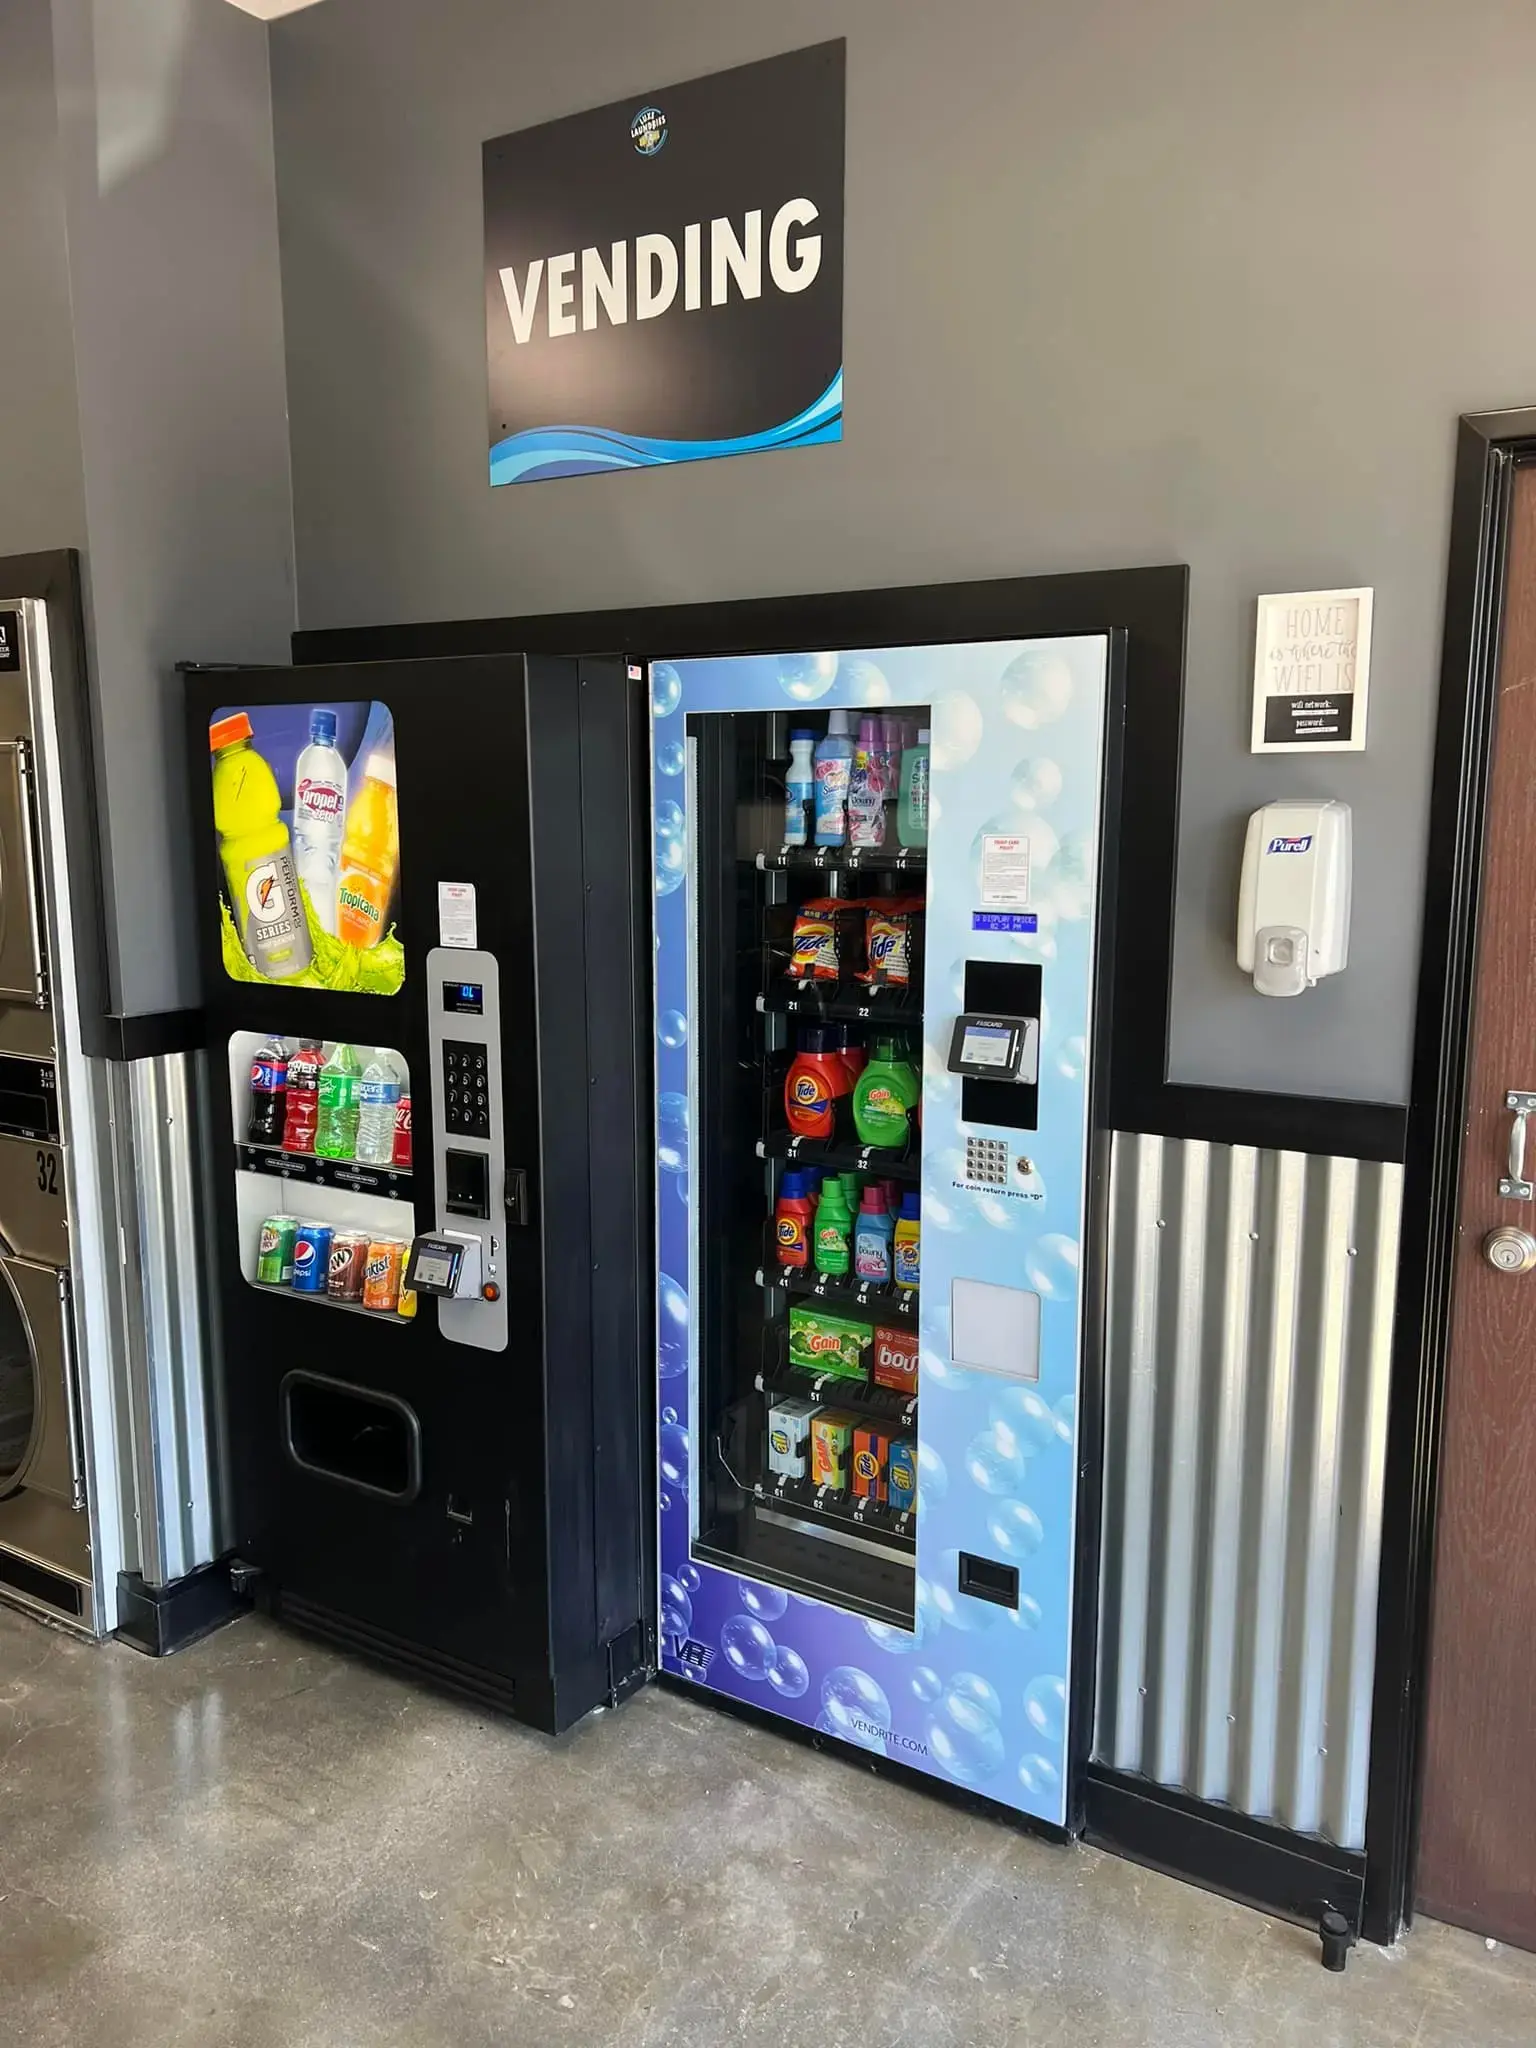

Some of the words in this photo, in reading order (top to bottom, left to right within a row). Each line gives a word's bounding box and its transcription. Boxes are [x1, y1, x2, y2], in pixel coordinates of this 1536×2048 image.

[498, 197, 823, 344] VENDING
[1286, 606, 1345, 638] HOME
[1273, 663, 1323, 693] WIFI
[1335, 662, 1354, 692] IS
[303, 789, 338, 810] propel
[312, 808, 336, 824] zero
[1273, 839, 1308, 852] Purell
[777, 857, 787, 865] 11
[814, 857, 824, 867] 12
[848, 859, 858, 868] 13
[895, 860, 906, 868] 14
[246, 861, 287, 923] G
[280, 855, 301, 917] PERFORM
[339, 887, 380, 922] Tropicana
[256, 921, 291, 941] SERIES
[794, 935, 830, 951] Tide
[872, 935, 897, 960] Tide
[788, 1001, 798, 1010] 21
[858, 1007, 869, 1017] 22
[797, 1083, 816, 1097] Tide
[870, 1089, 890, 1100] Gain
[787, 1148, 797, 1158] 31
[857, 1160, 868, 1169] 32
[37, 1150, 58, 1196] 32
[965, 1184, 982, 1192] coin
[983, 1187, 1006, 1195] return
[1007, 1191, 1029, 1199] press
[779, 1224, 795, 1236] Tide
[821, 1230, 837, 1239] Gain
[779, 1278, 789, 1287] 41
[814, 1286, 825, 1295] 42
[857, 1294, 867, 1304] 43
[899, 1303, 909, 1312] 44
[810, 1334, 841, 1353] Gain
[810, 1392, 820, 1401] 51
[901, 1416, 912, 1425] 52
[816, 1436, 833, 1473] Gain
[860, 1453, 875, 1477] Tide
[813, 1500, 823, 1509] 62
[853, 1512, 864, 1521] 63
[895, 1524, 905, 1534] 64
[851, 1719, 928, 1756] VENDRITE.COM
